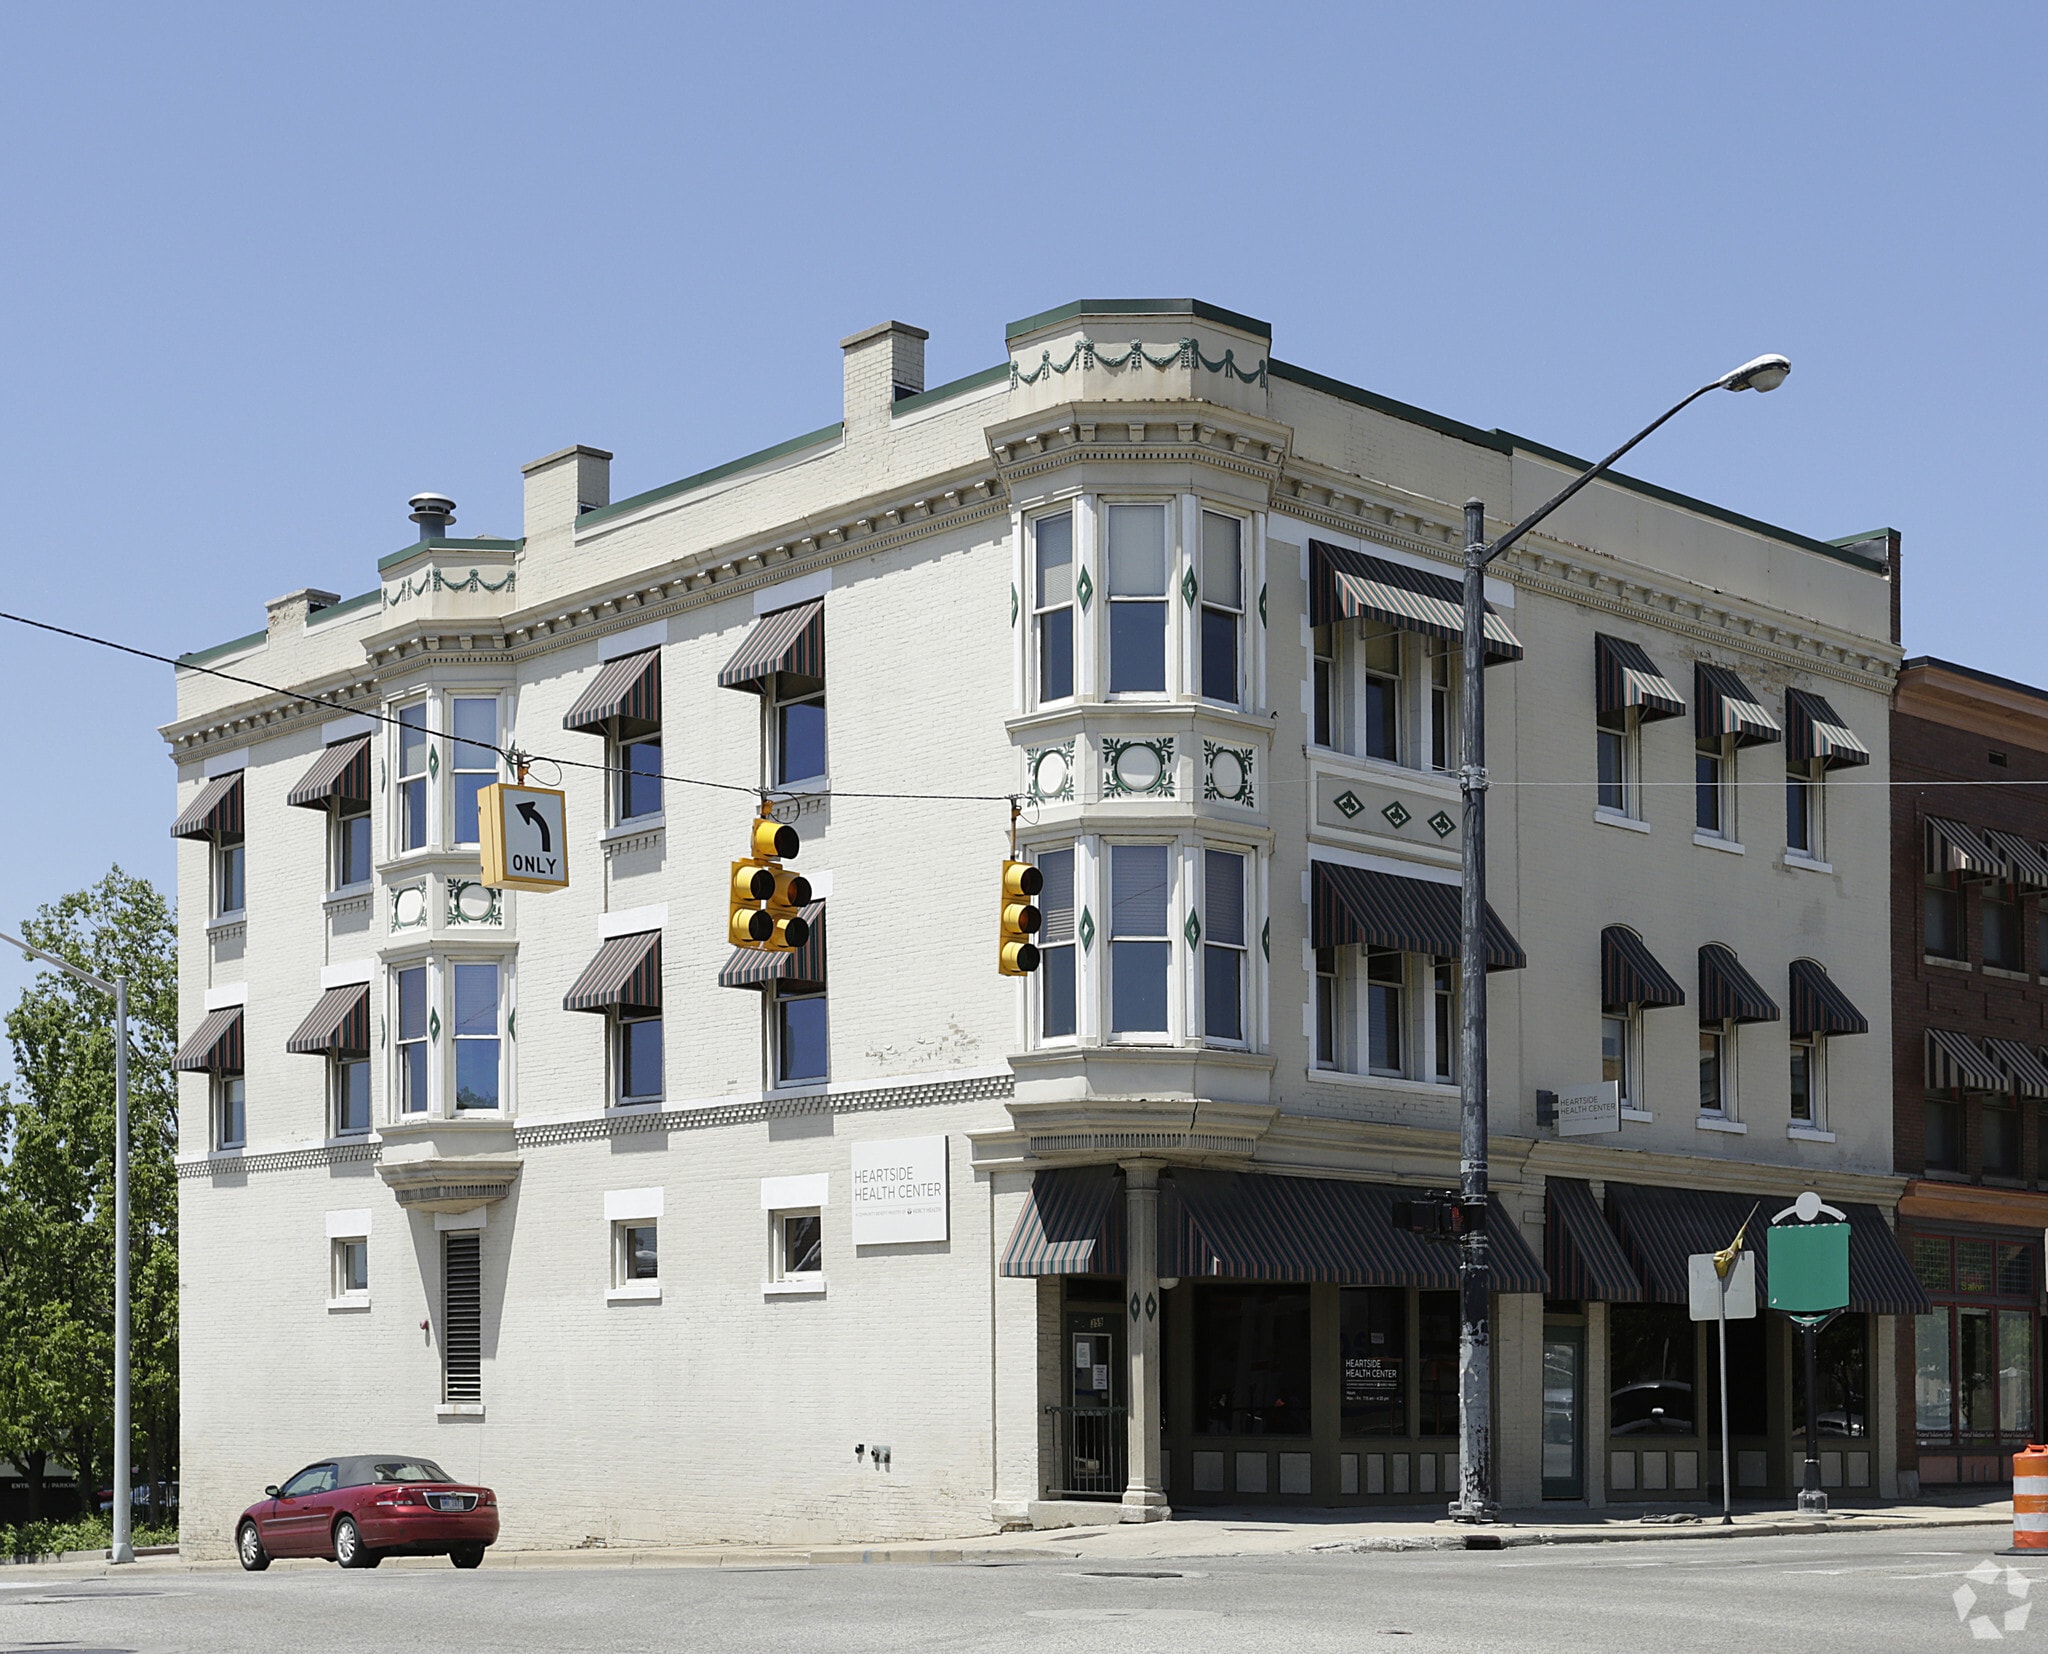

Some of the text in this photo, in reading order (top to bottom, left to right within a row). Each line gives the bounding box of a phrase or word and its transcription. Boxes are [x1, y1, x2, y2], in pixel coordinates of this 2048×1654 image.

[513, 854, 557, 874] ONLY
[1560, 1095, 1598, 1106] HEARTSIDE
[1560, 1102, 1616, 1115] HEALTH CENTER
[855, 1166, 914, 1184] HEARTSIDE
[855, 1182, 942, 1201] HEALTH CENTER
[1345, 1359, 1382, 1368] HEARTSIDE
[1345, 1369, 1397, 1378] HEALTH CENTER
